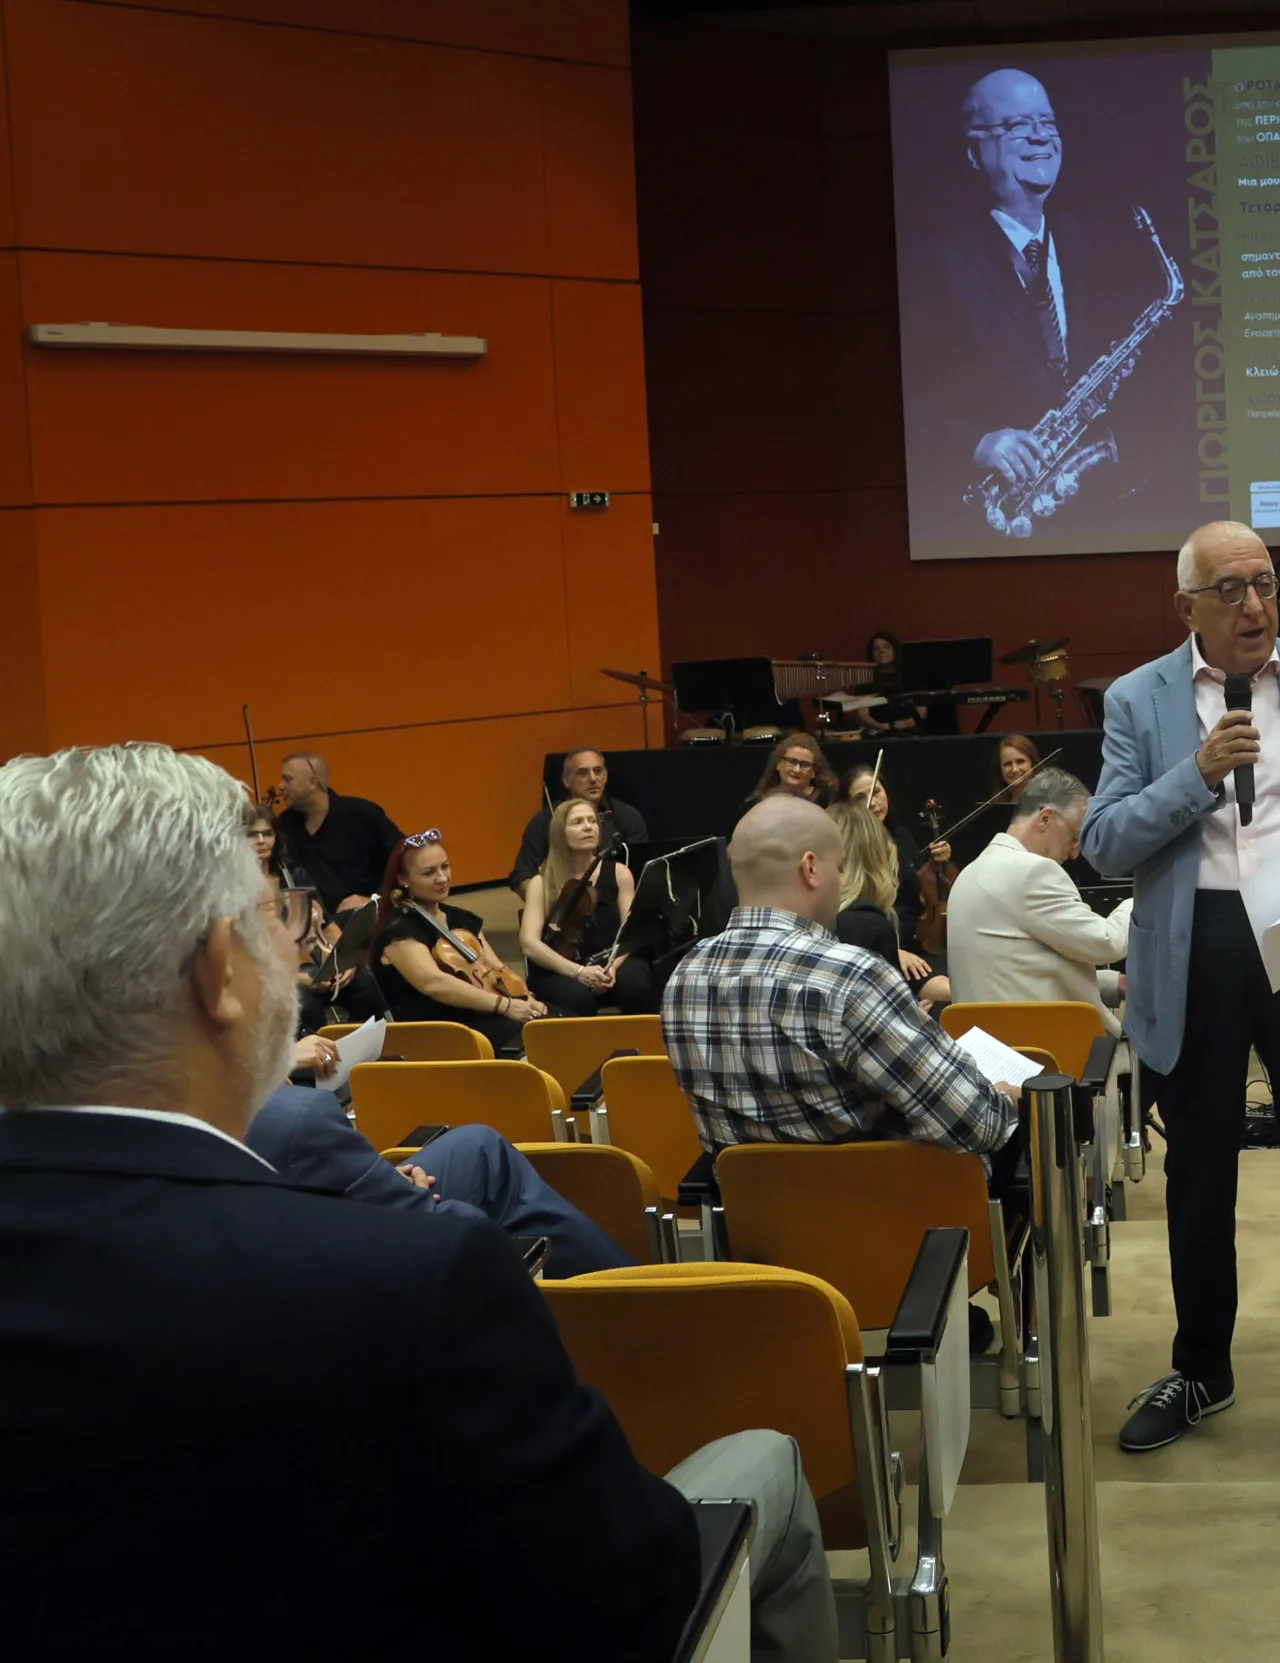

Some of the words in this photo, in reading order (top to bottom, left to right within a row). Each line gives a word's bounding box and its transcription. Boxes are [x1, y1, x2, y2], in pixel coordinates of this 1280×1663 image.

[1238, 177, 1258, 188] Μια
[1182, 75, 1222, 306] ΚΑΤΣΑΡΟΣ
[1242, 268, 1263, 279] από
[1245, 365, 1279, 377] Κλειώ
[1193, 320, 1229, 505] ΓΙΩΡΓΟΣ
